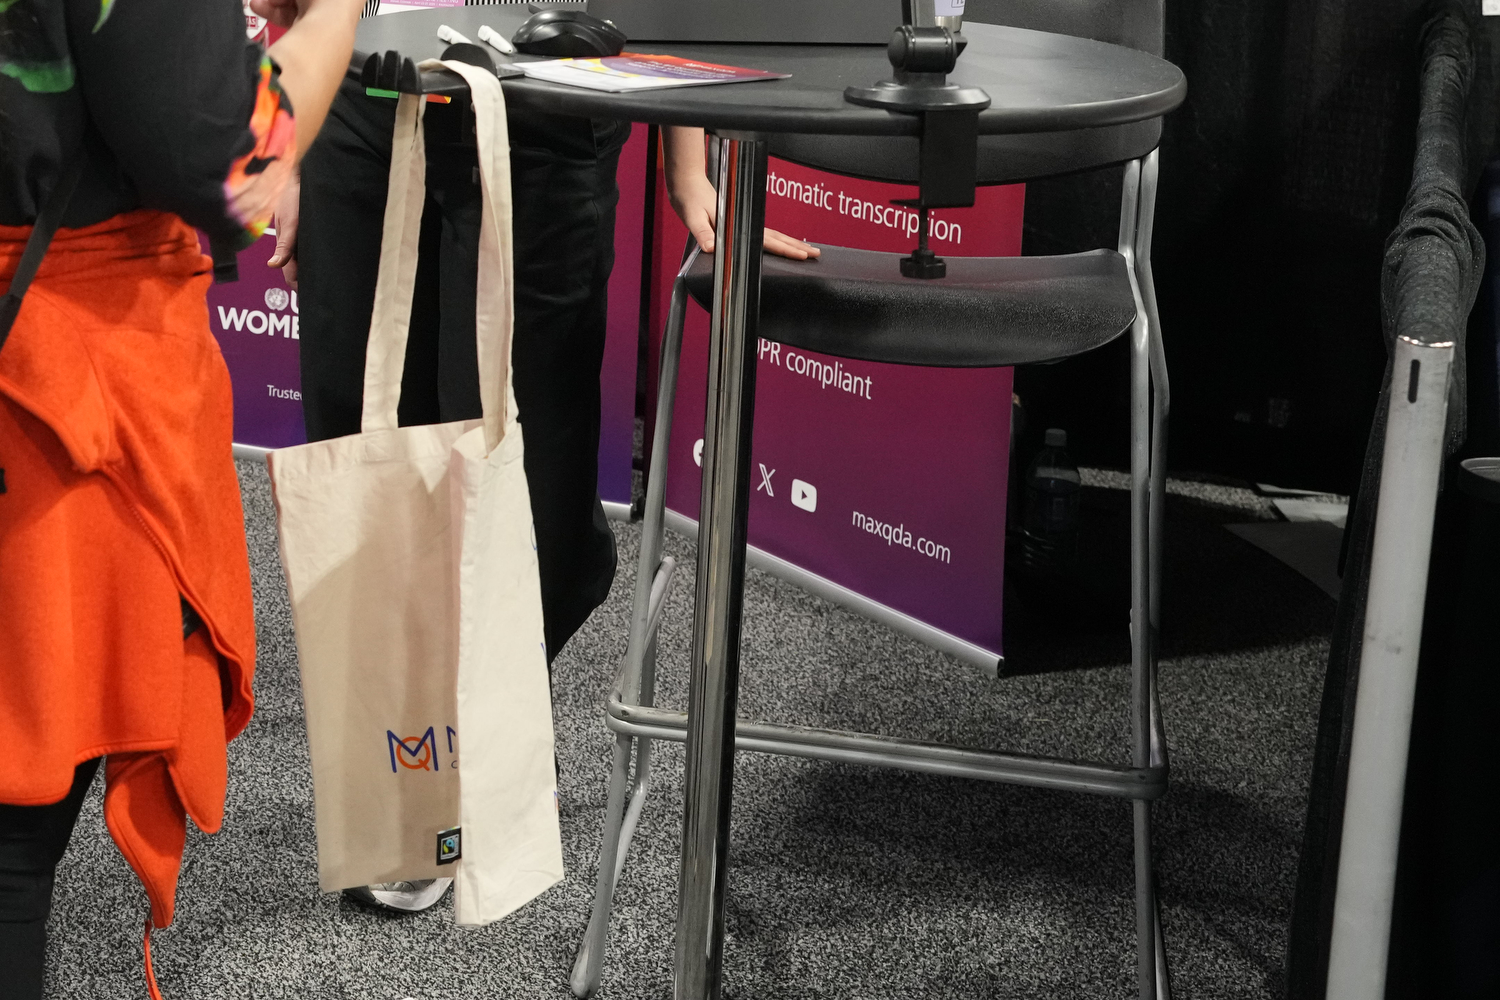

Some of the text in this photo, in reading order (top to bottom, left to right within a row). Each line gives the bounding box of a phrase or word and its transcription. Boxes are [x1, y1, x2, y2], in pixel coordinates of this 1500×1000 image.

[766, 171, 962, 244] tomatic transcripion
[217, 306, 300, 340] WOME
[267, 384, 302, 401] Truste
[785, 351, 873, 400] compliant
[851, 508, 952, 565] maxqda.com
